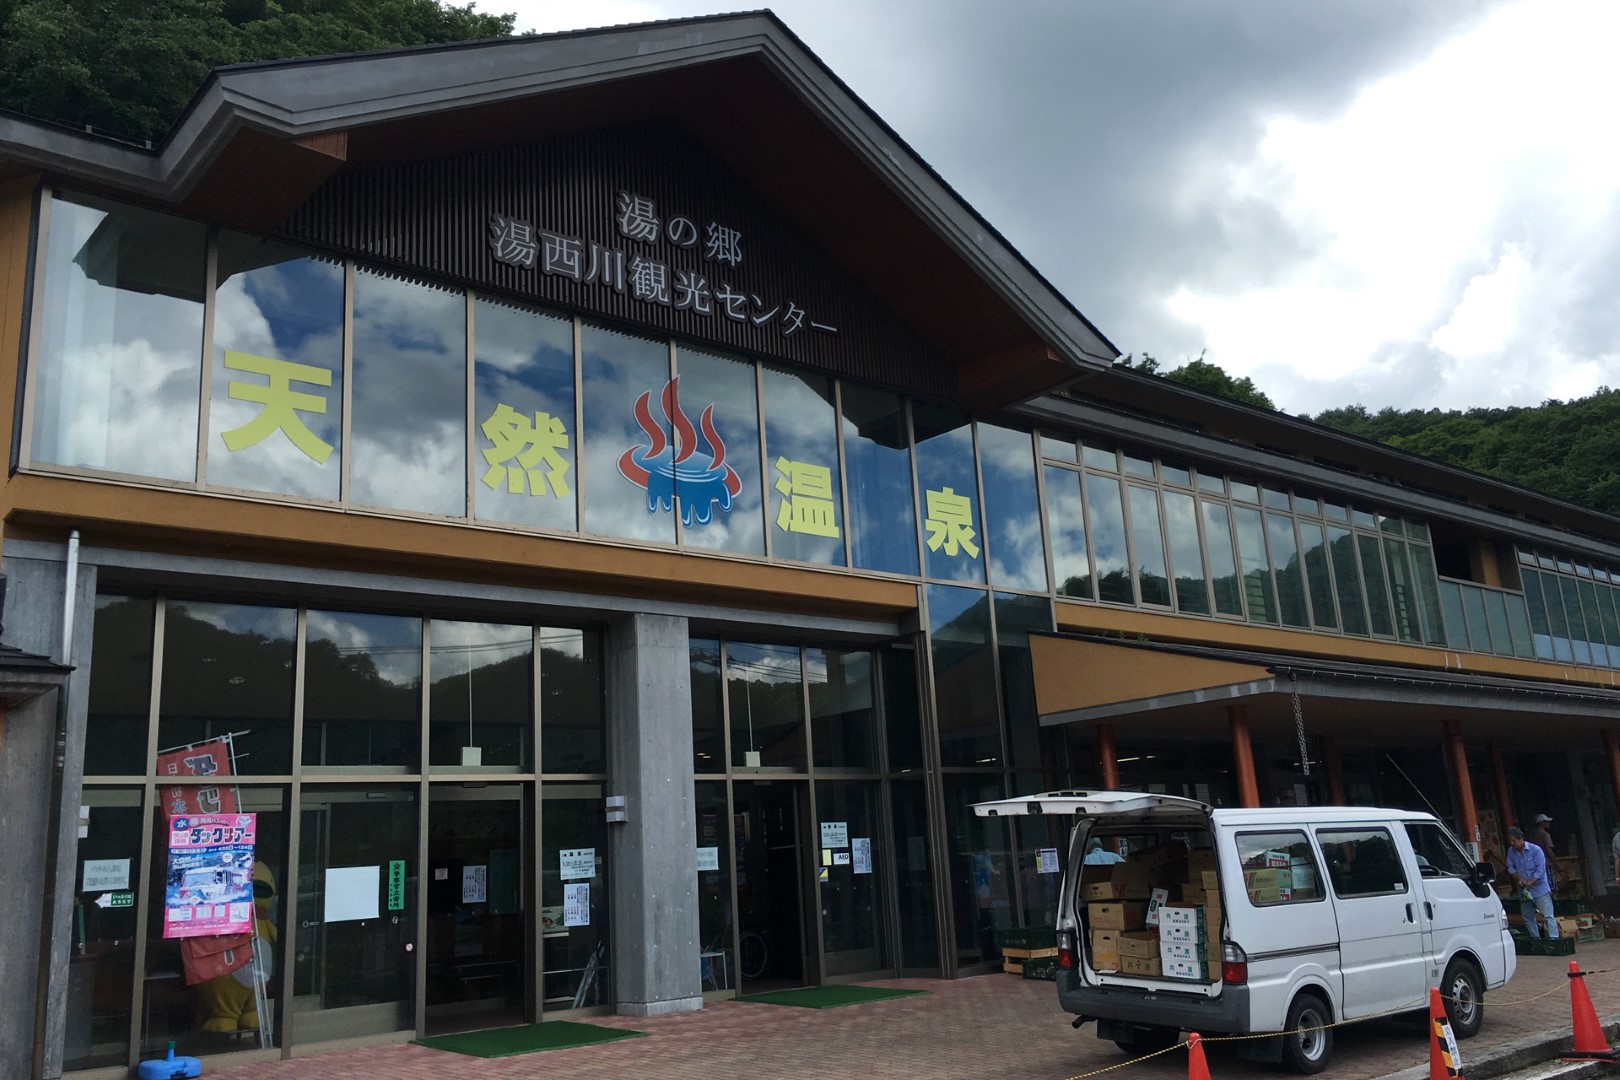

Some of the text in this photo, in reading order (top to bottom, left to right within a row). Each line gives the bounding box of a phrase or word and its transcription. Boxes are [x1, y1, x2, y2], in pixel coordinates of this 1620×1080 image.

[618, 192, 743, 267] 湯の郷
[493, 216, 838, 335] 湯西川観光センター
[190, 827, 254, 845] ダックツアー
